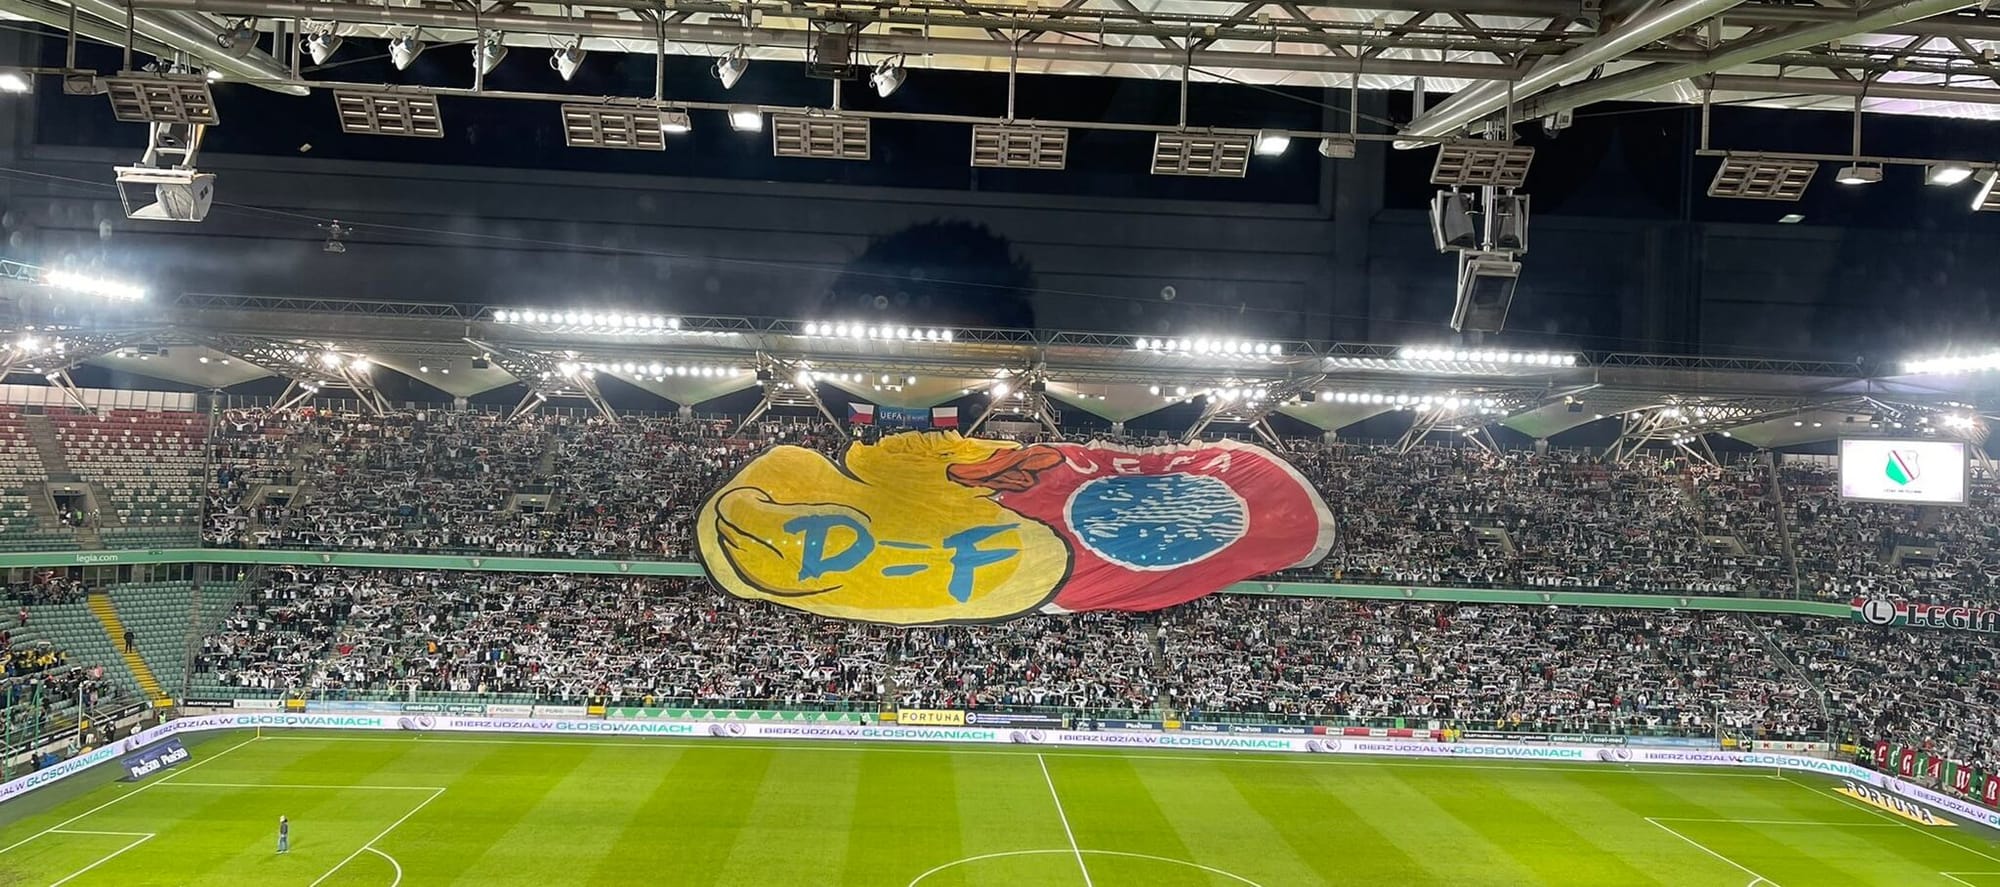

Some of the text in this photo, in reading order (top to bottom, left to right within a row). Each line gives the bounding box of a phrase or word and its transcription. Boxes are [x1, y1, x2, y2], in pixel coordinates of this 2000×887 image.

[880, 411, 903, 420] UEFA
[1065, 452, 1232, 475] UEFA
[76, 552, 118, 563] legia.com
[1905, 604, 2000, 633] LEGIA
[219, 717, 233, 725] W
[237, 714, 381, 727] GŁOSOWANIACH
[902, 712, 961, 722] FORTUNA
[556, 721, 693, 733] GŁOSOWANIACH
[862, 728, 995, 740] GŁOSOWANIACH
[1159, 736, 1290, 749] GŁOSOWANIACH
[160, 747, 188, 767] Plus500
[1454, 746, 1583, 758] GŁOSOWANIACH
[27, 748, 114, 788] GŁOSOWANIACH
[131, 759, 161, 778] Plus500
[1743, 755, 1872, 782] GŁOSOWANIACH
[1843, 780, 1934, 825] FORTUNA
[1977, 811, 1987, 820] W
